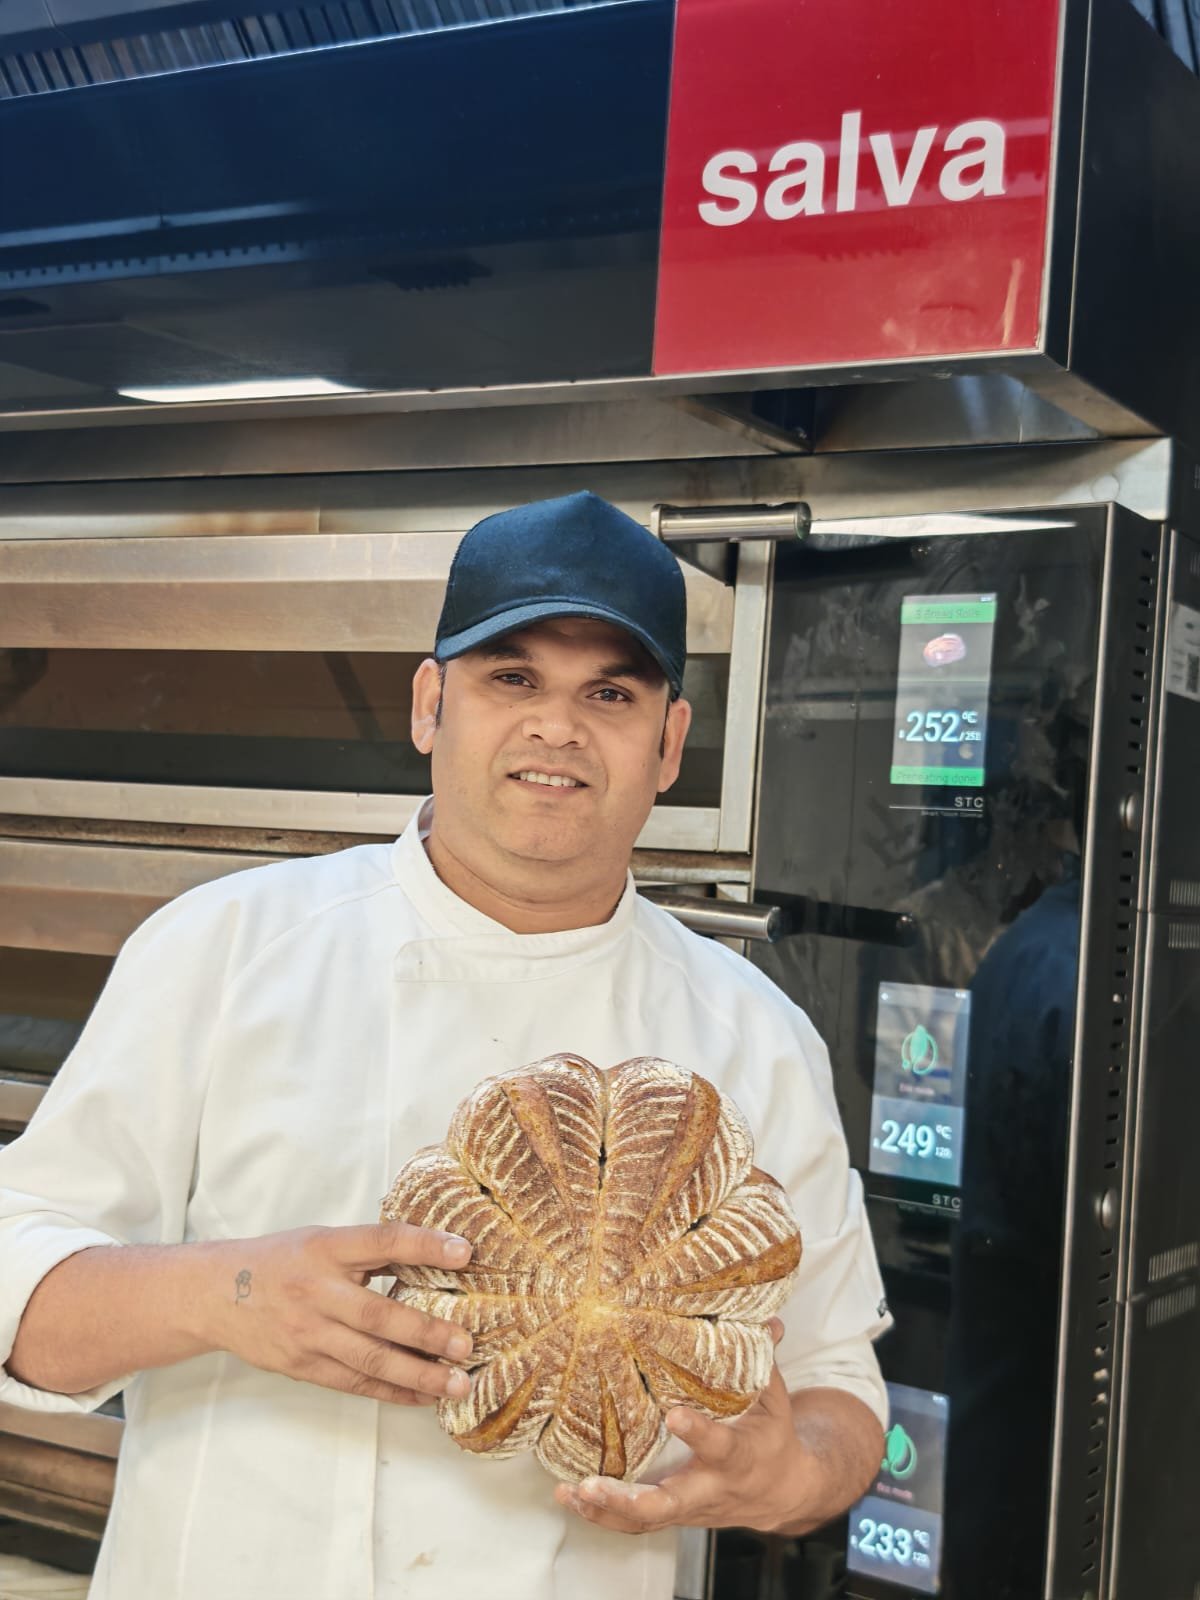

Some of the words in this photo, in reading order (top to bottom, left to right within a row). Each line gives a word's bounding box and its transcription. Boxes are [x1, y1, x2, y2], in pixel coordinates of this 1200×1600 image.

[698, 110, 1006, 227] salva
[906, 710, 959, 742] 252
[954, 796, 984, 808] STC
[880, 1119, 936, 1158] 249
[932, 1193, 961, 1209] STC
[858, 1518, 912, 1564] 233
